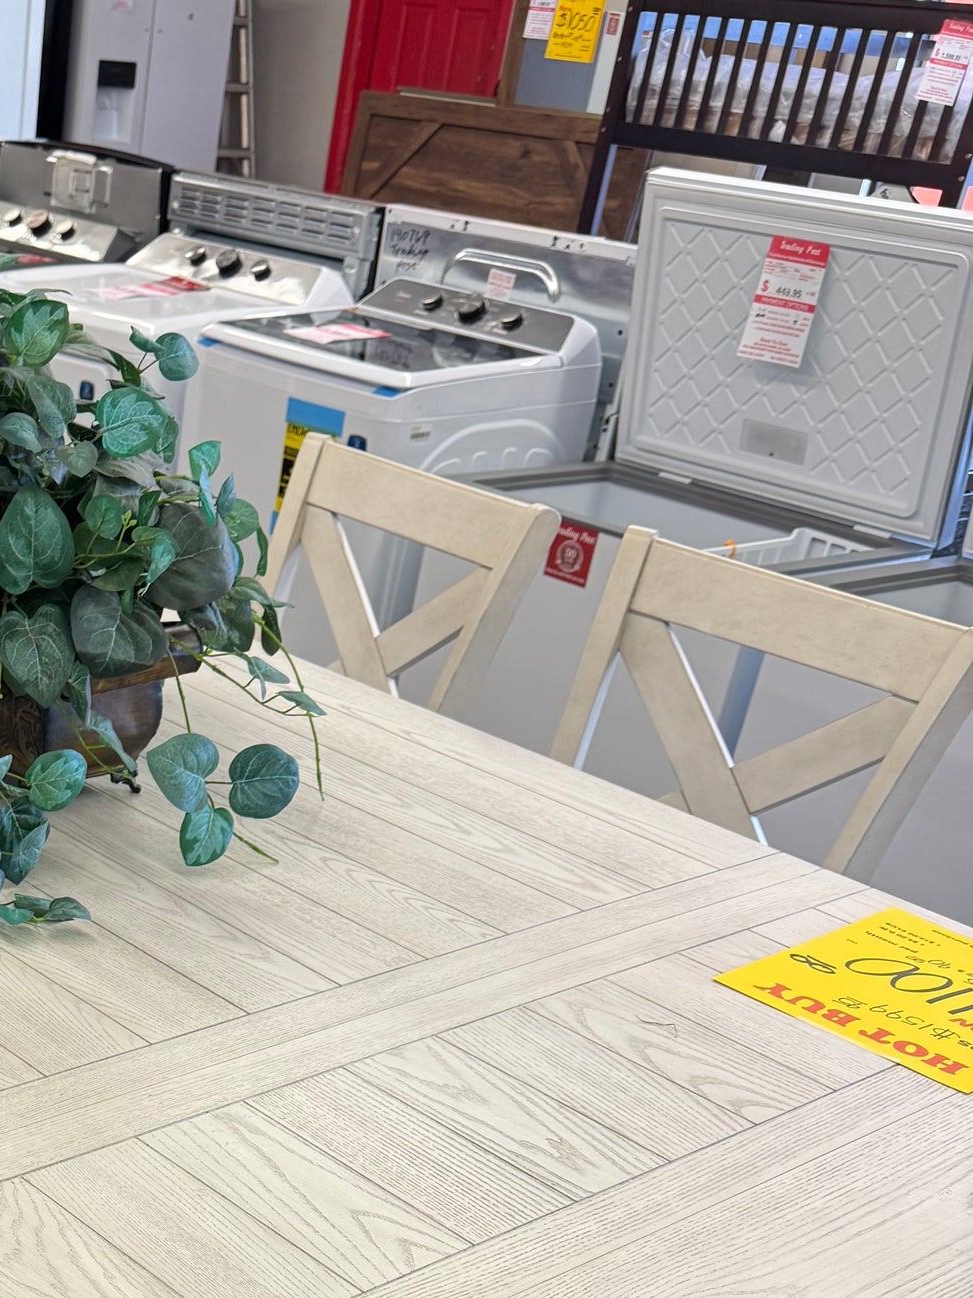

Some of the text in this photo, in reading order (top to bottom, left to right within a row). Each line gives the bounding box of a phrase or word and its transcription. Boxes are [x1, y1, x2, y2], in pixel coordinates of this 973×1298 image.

[865, 930, 898, 946] month
[753, 982, 970, 1076] HOT BUY
